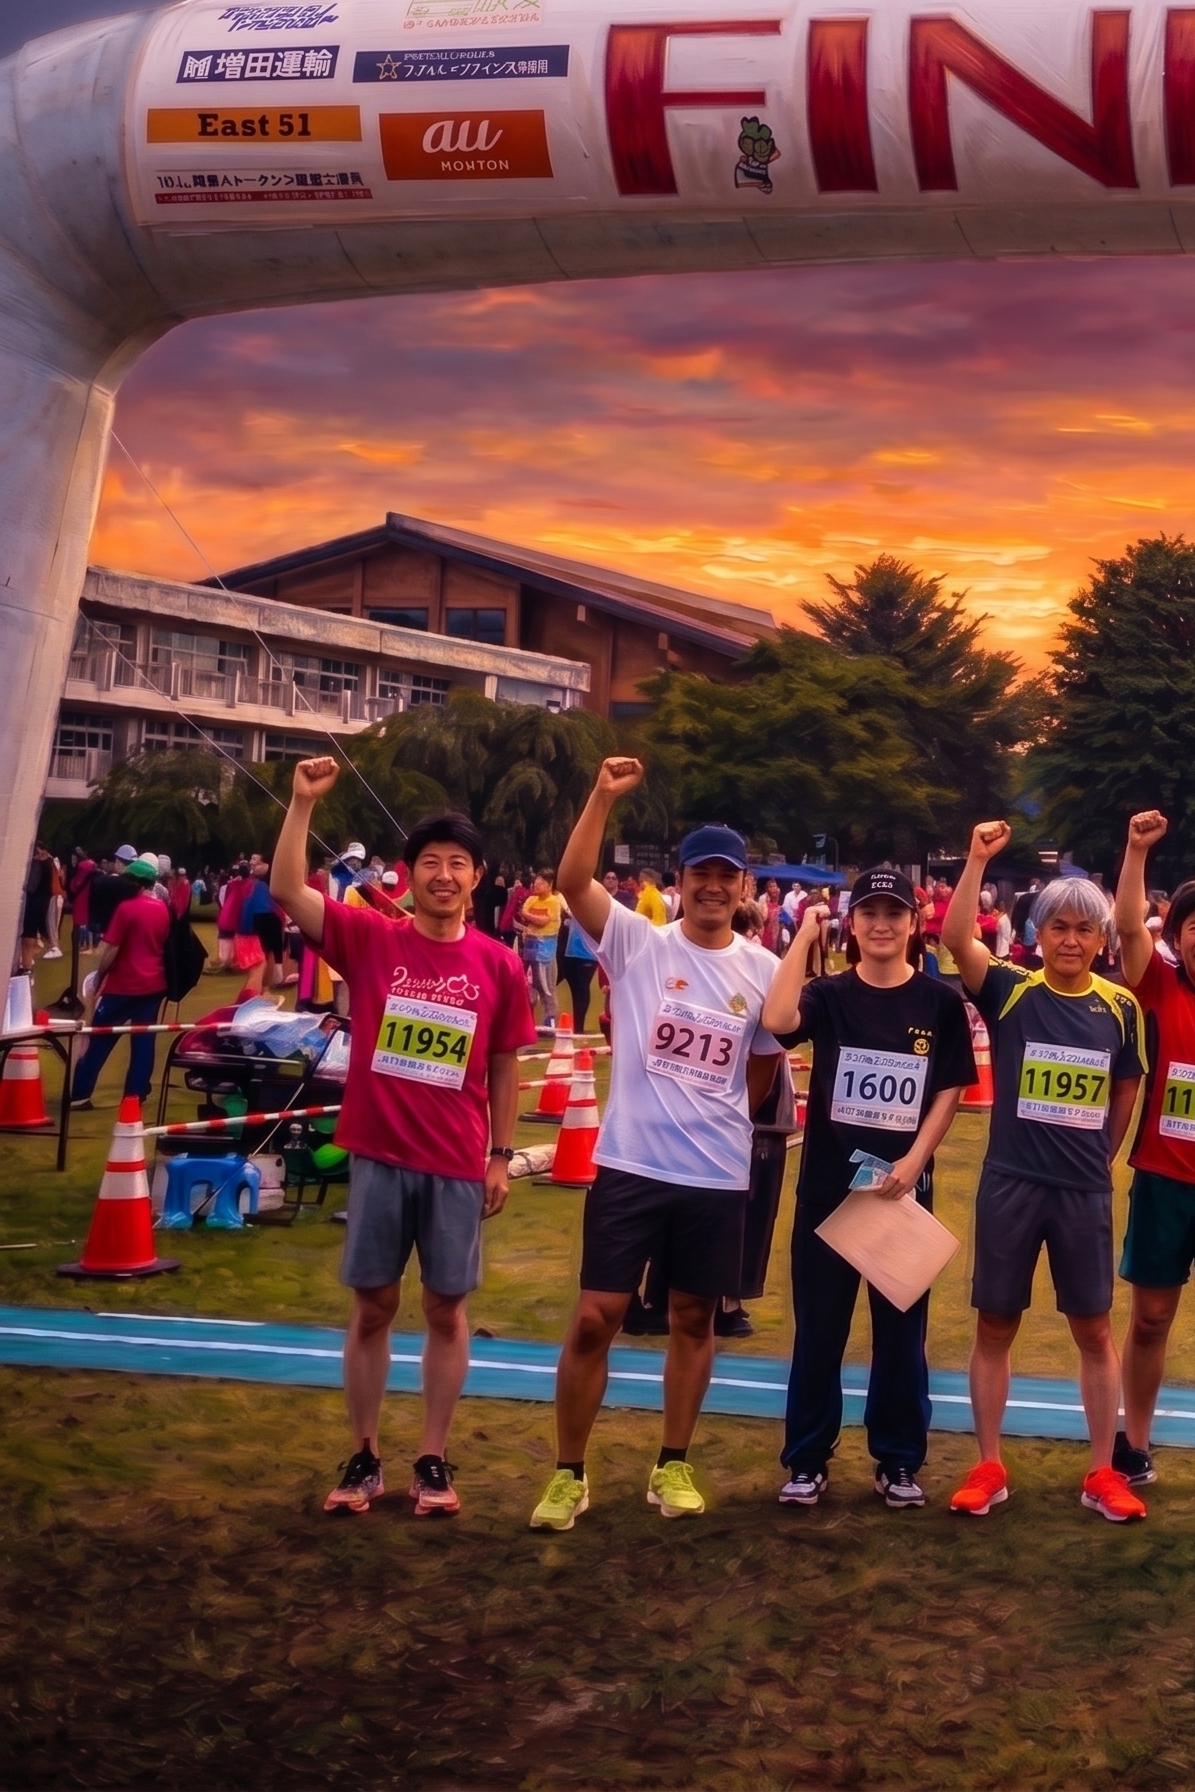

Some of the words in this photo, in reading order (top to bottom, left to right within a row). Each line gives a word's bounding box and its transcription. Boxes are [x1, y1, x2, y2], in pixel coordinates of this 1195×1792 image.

[214, 48, 333, 79] 増田運輸
[197, 112, 270, 138] East
[278, 112, 312, 137] 51
[422, 119, 504, 154] au
[386, 1021, 467, 1064] 11954
[655, 1022, 733, 1067] 9213
[843, 1070, 917, 1105] 1600
[1025, 1067, 1106, 1103] 11957
